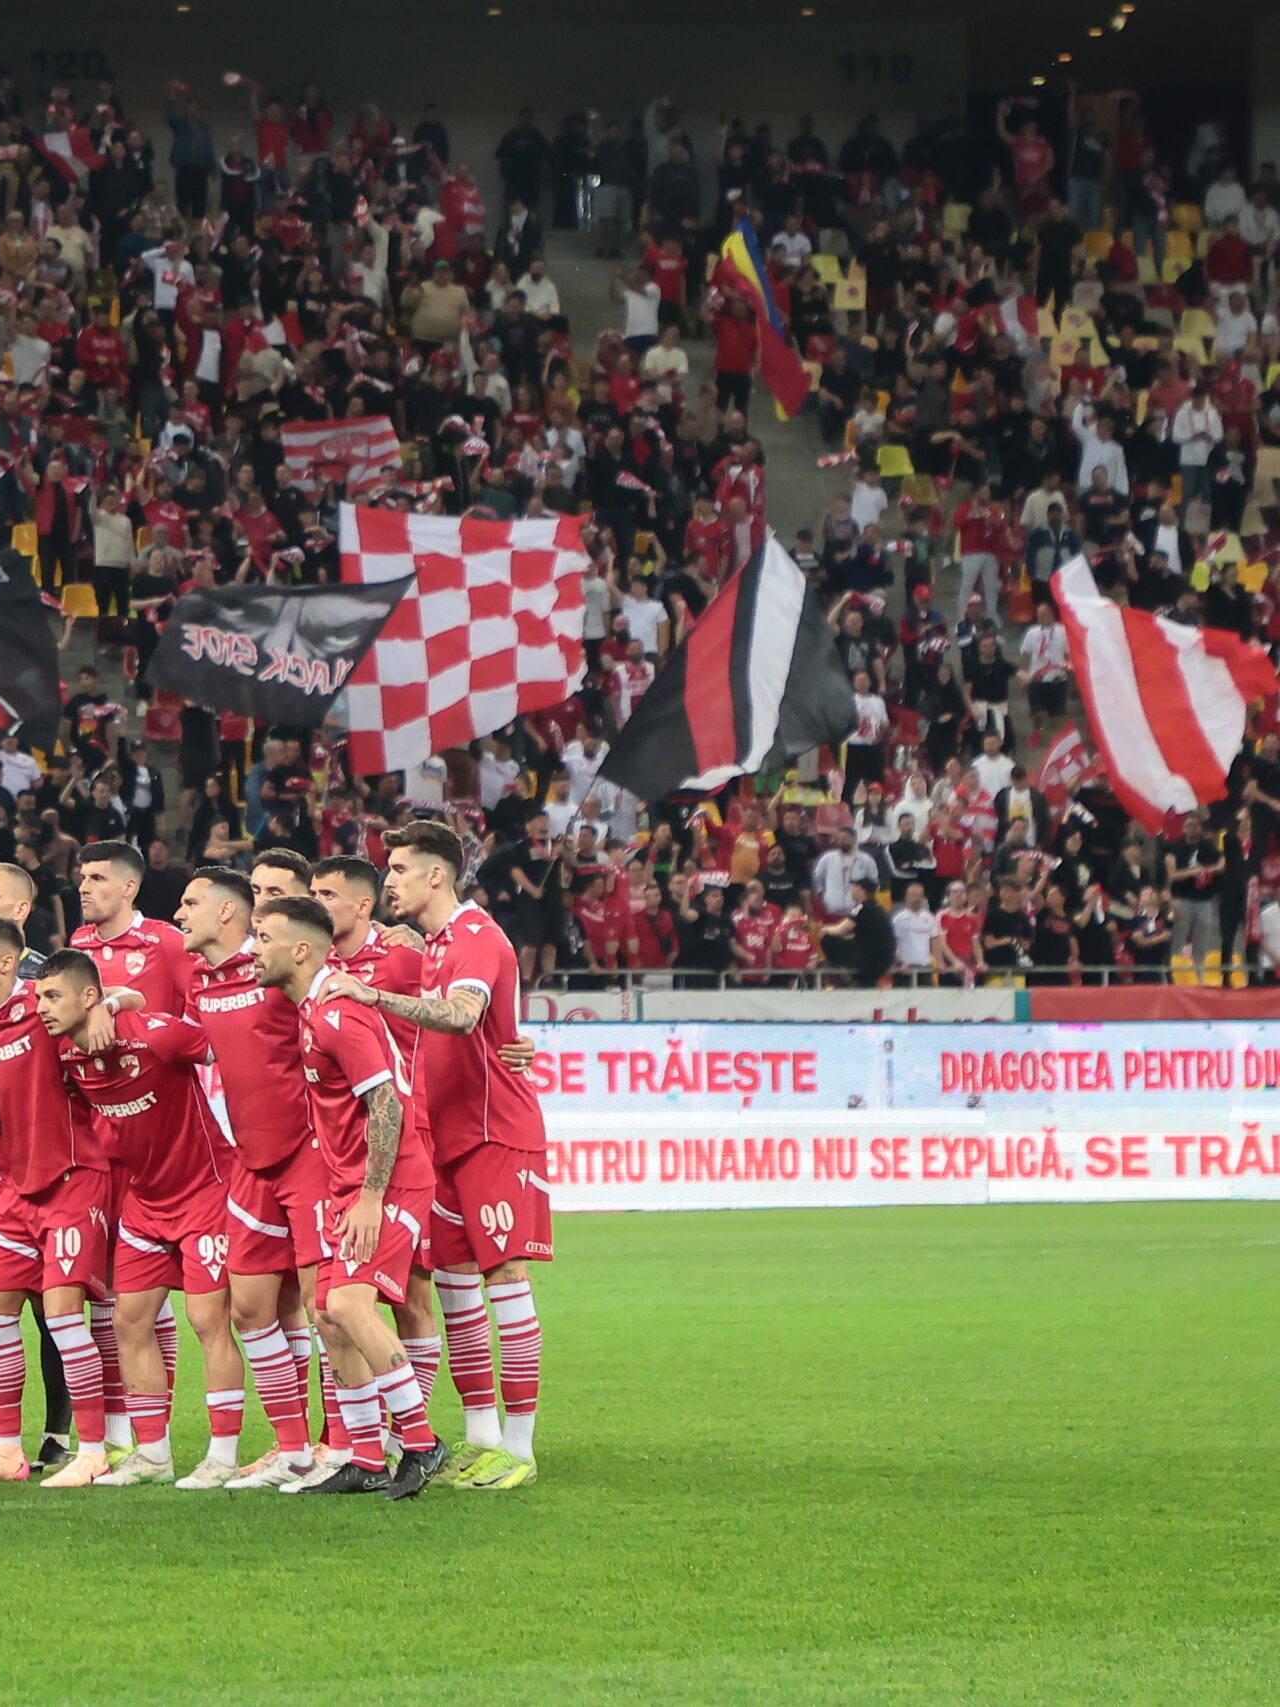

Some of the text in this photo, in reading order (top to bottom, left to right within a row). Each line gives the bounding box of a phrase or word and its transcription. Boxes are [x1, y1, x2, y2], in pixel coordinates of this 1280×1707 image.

[199, 987, 266, 1013] SUPERBET
[532, 1038, 818, 1108] SE TRĂIEȘTE
[940, 1050, 1114, 1093] DRAGOSTEA
[1123, 1049, 1233, 1091] PENTRU
[546, 1139, 647, 1184] ENTRU
[658, 1137, 799, 1183] DINAMO
[813, 1137, 858, 1182] NU
[871, 1138, 911, 1181] SE
[921, 1126, 1074, 1184] EXPLICĂ,
[1084, 1137, 1150, 1179] SE
[479, 1200, 515, 1236] 90
[54, 1226, 82, 1258] 10
[198, 1233, 230, 1265] 98
